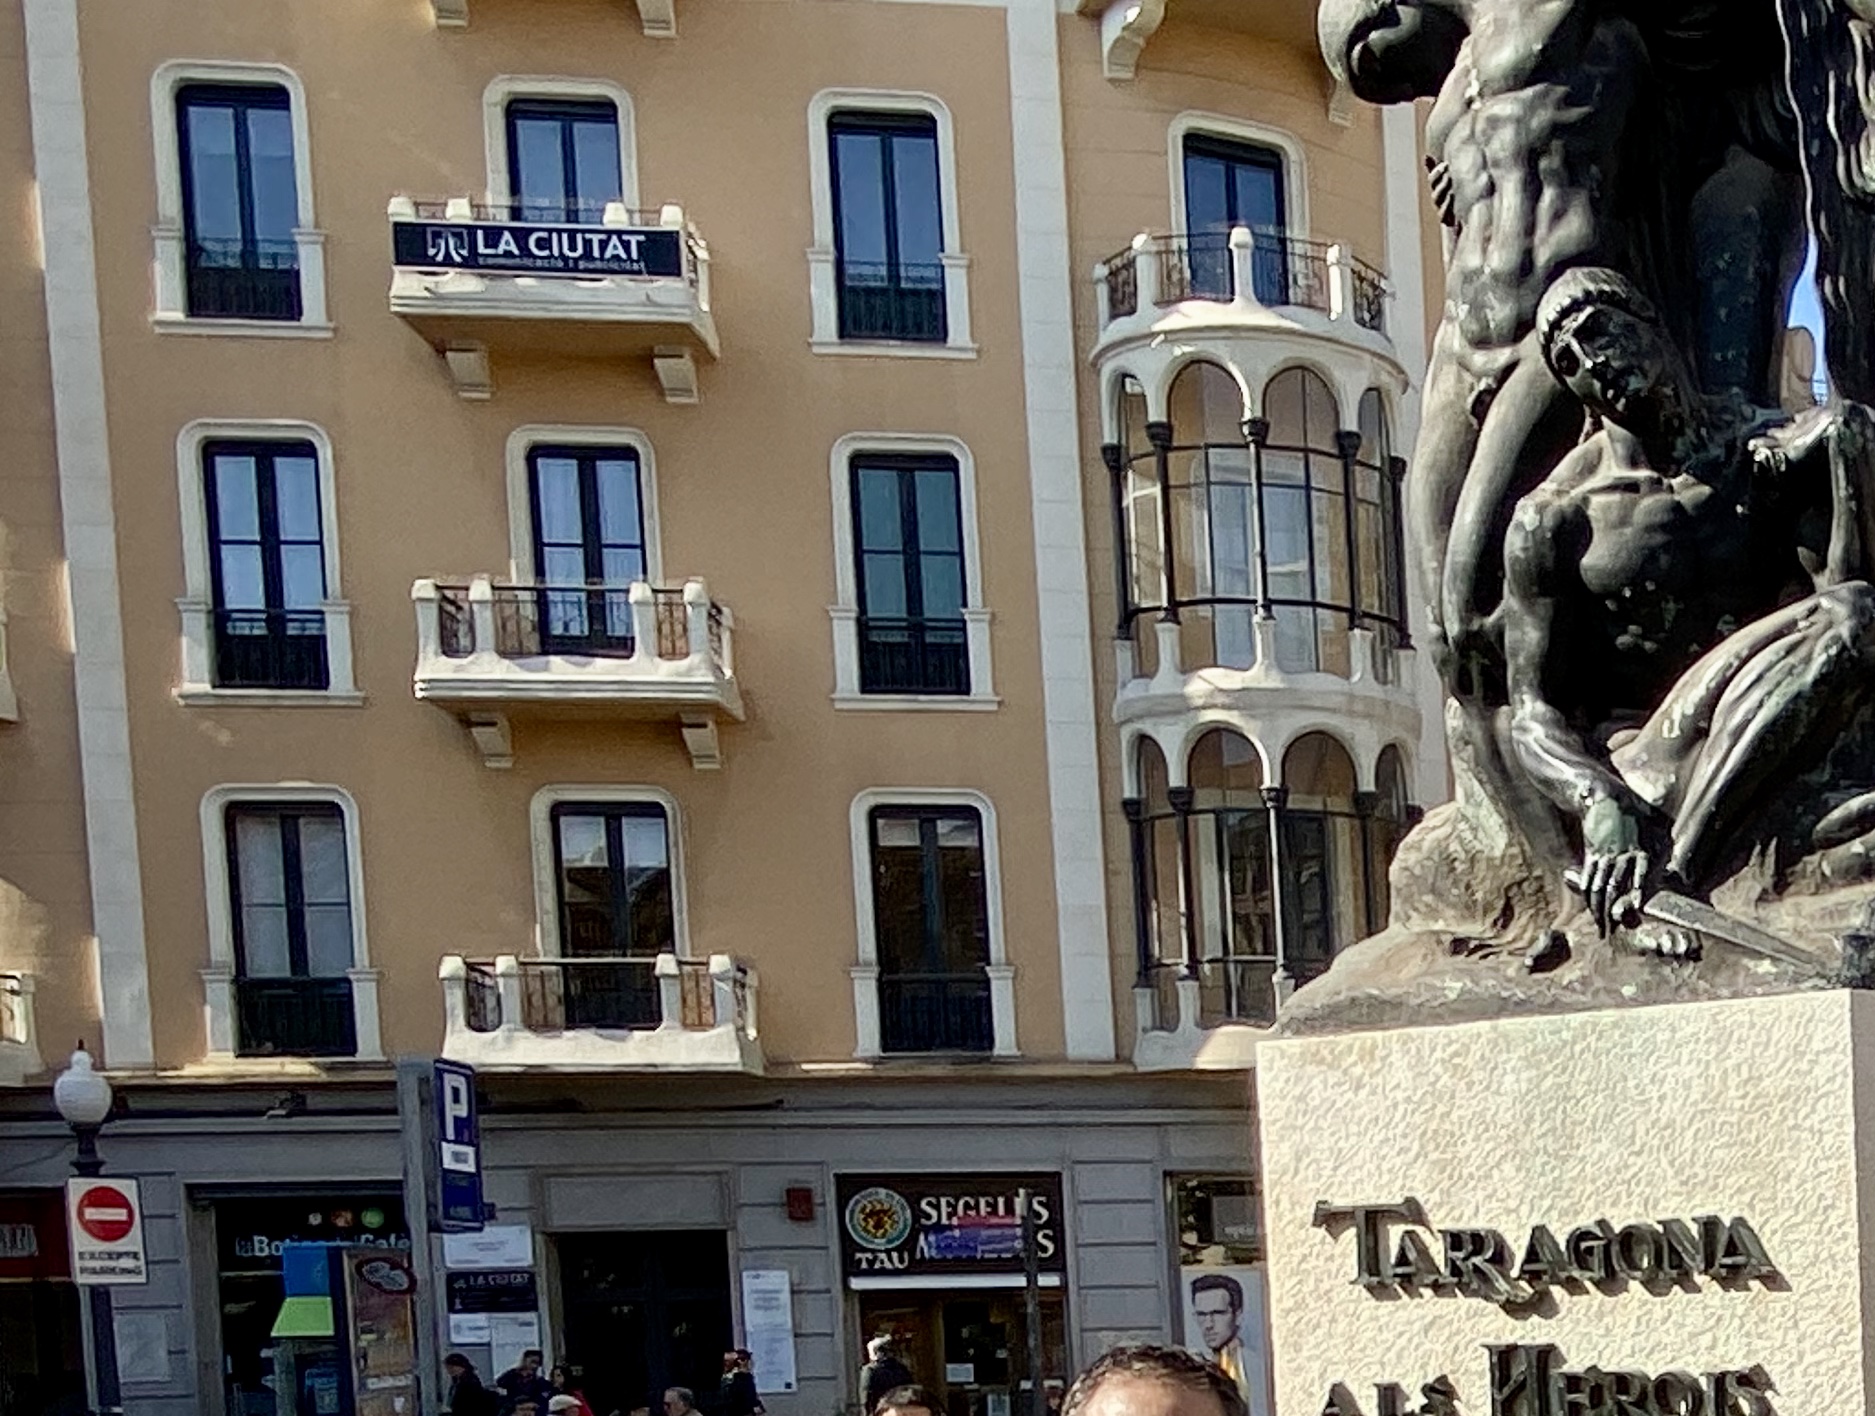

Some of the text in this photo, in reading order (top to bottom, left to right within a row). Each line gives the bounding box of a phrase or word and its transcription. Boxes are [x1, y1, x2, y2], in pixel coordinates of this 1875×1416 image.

[476, 229, 647, 260] LA CIUTAT
[443, 1072, 468, 1140] P
[854, 1251, 909, 1270] TAU
